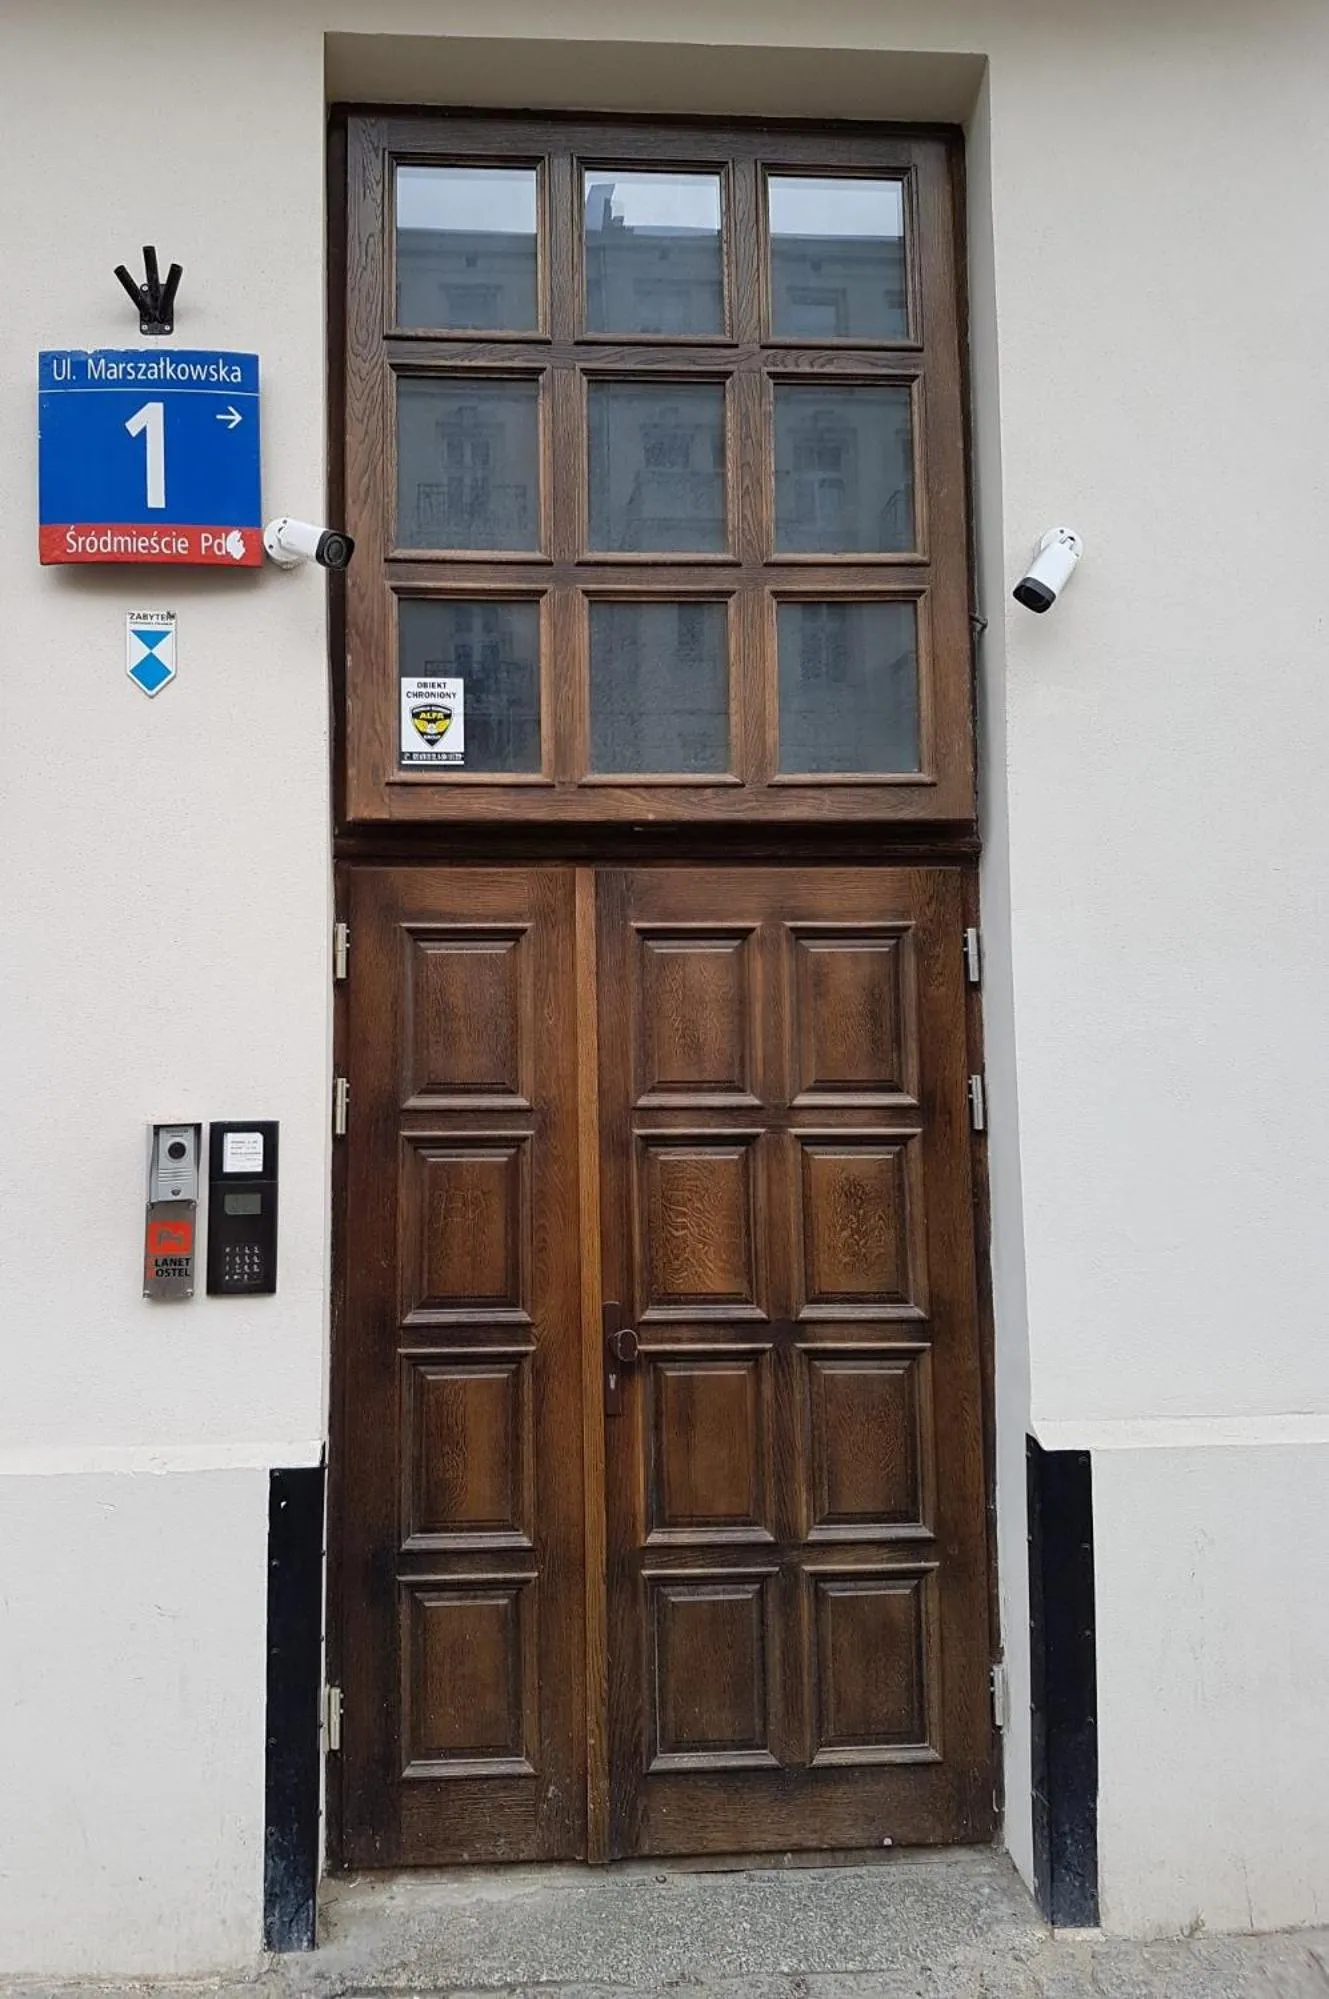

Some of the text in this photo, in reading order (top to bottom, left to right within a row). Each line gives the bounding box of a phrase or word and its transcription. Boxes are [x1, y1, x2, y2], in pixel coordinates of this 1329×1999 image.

[52, 357, 242, 383] Ul. Marszałkowska
[125, 401, 166, 509] 1
[66, 525, 189, 555] Śródmieście
[406, 690, 457, 699] CHRONIONY
[416, 681, 447, 689] OBIEKT
